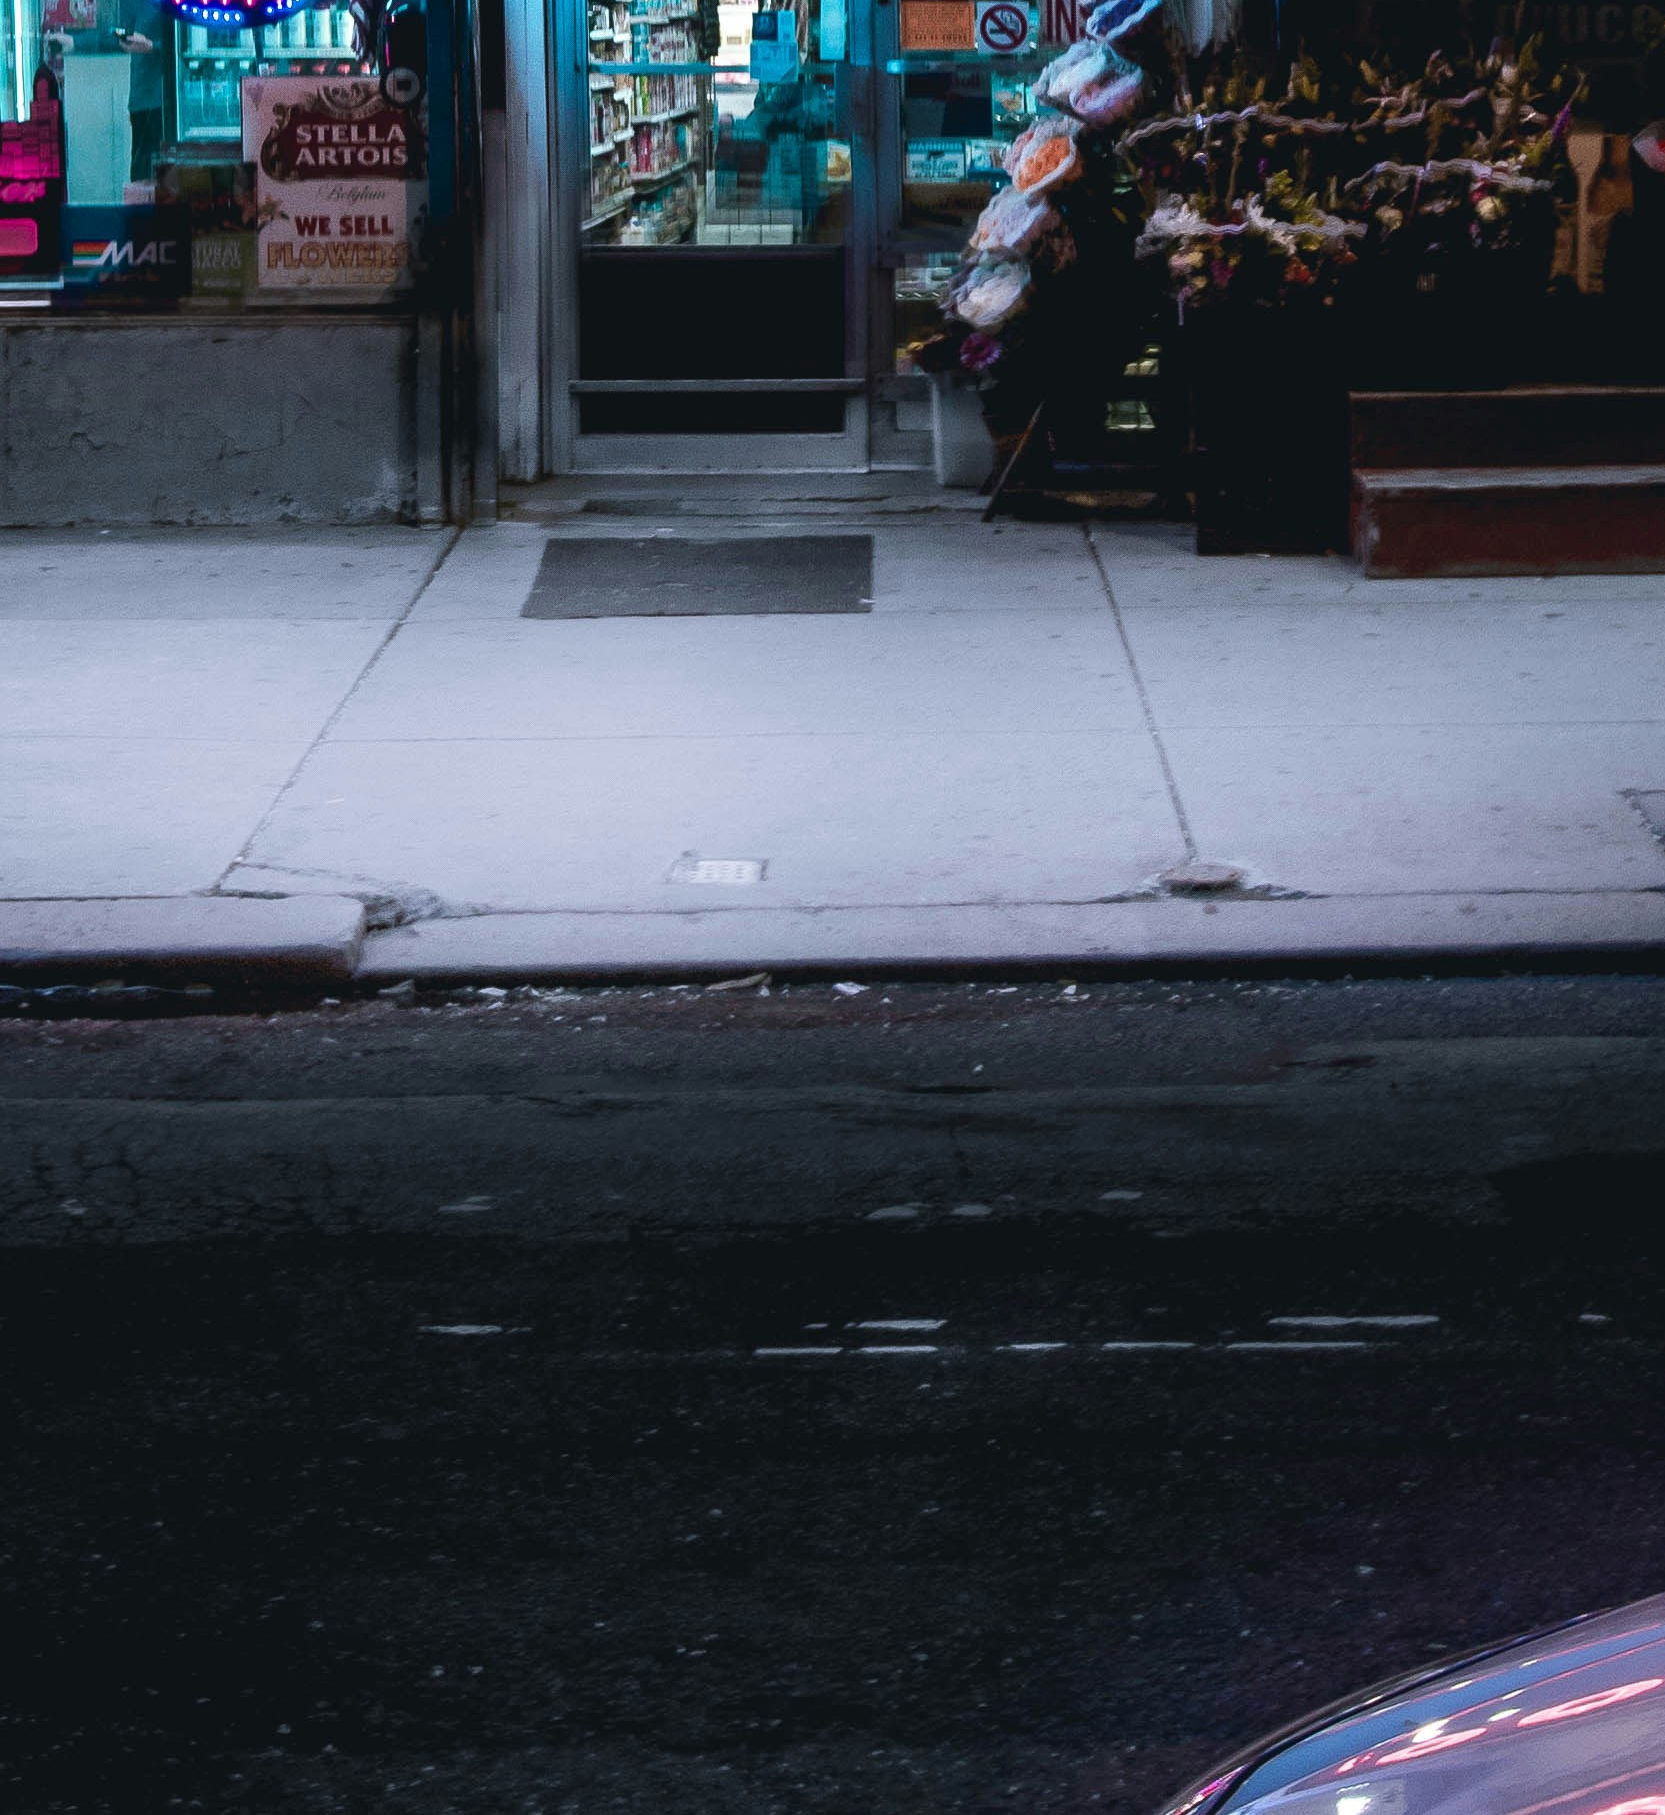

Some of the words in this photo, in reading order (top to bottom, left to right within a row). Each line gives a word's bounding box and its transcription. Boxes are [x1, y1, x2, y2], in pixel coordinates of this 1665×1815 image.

[295, 123, 407, 145] STELLA
[295, 145, 409, 167] ARTOIS
[295, 215, 332, 237] WE
[338, 215, 394, 237] SELL
[98, 240, 178, 266] MAC
